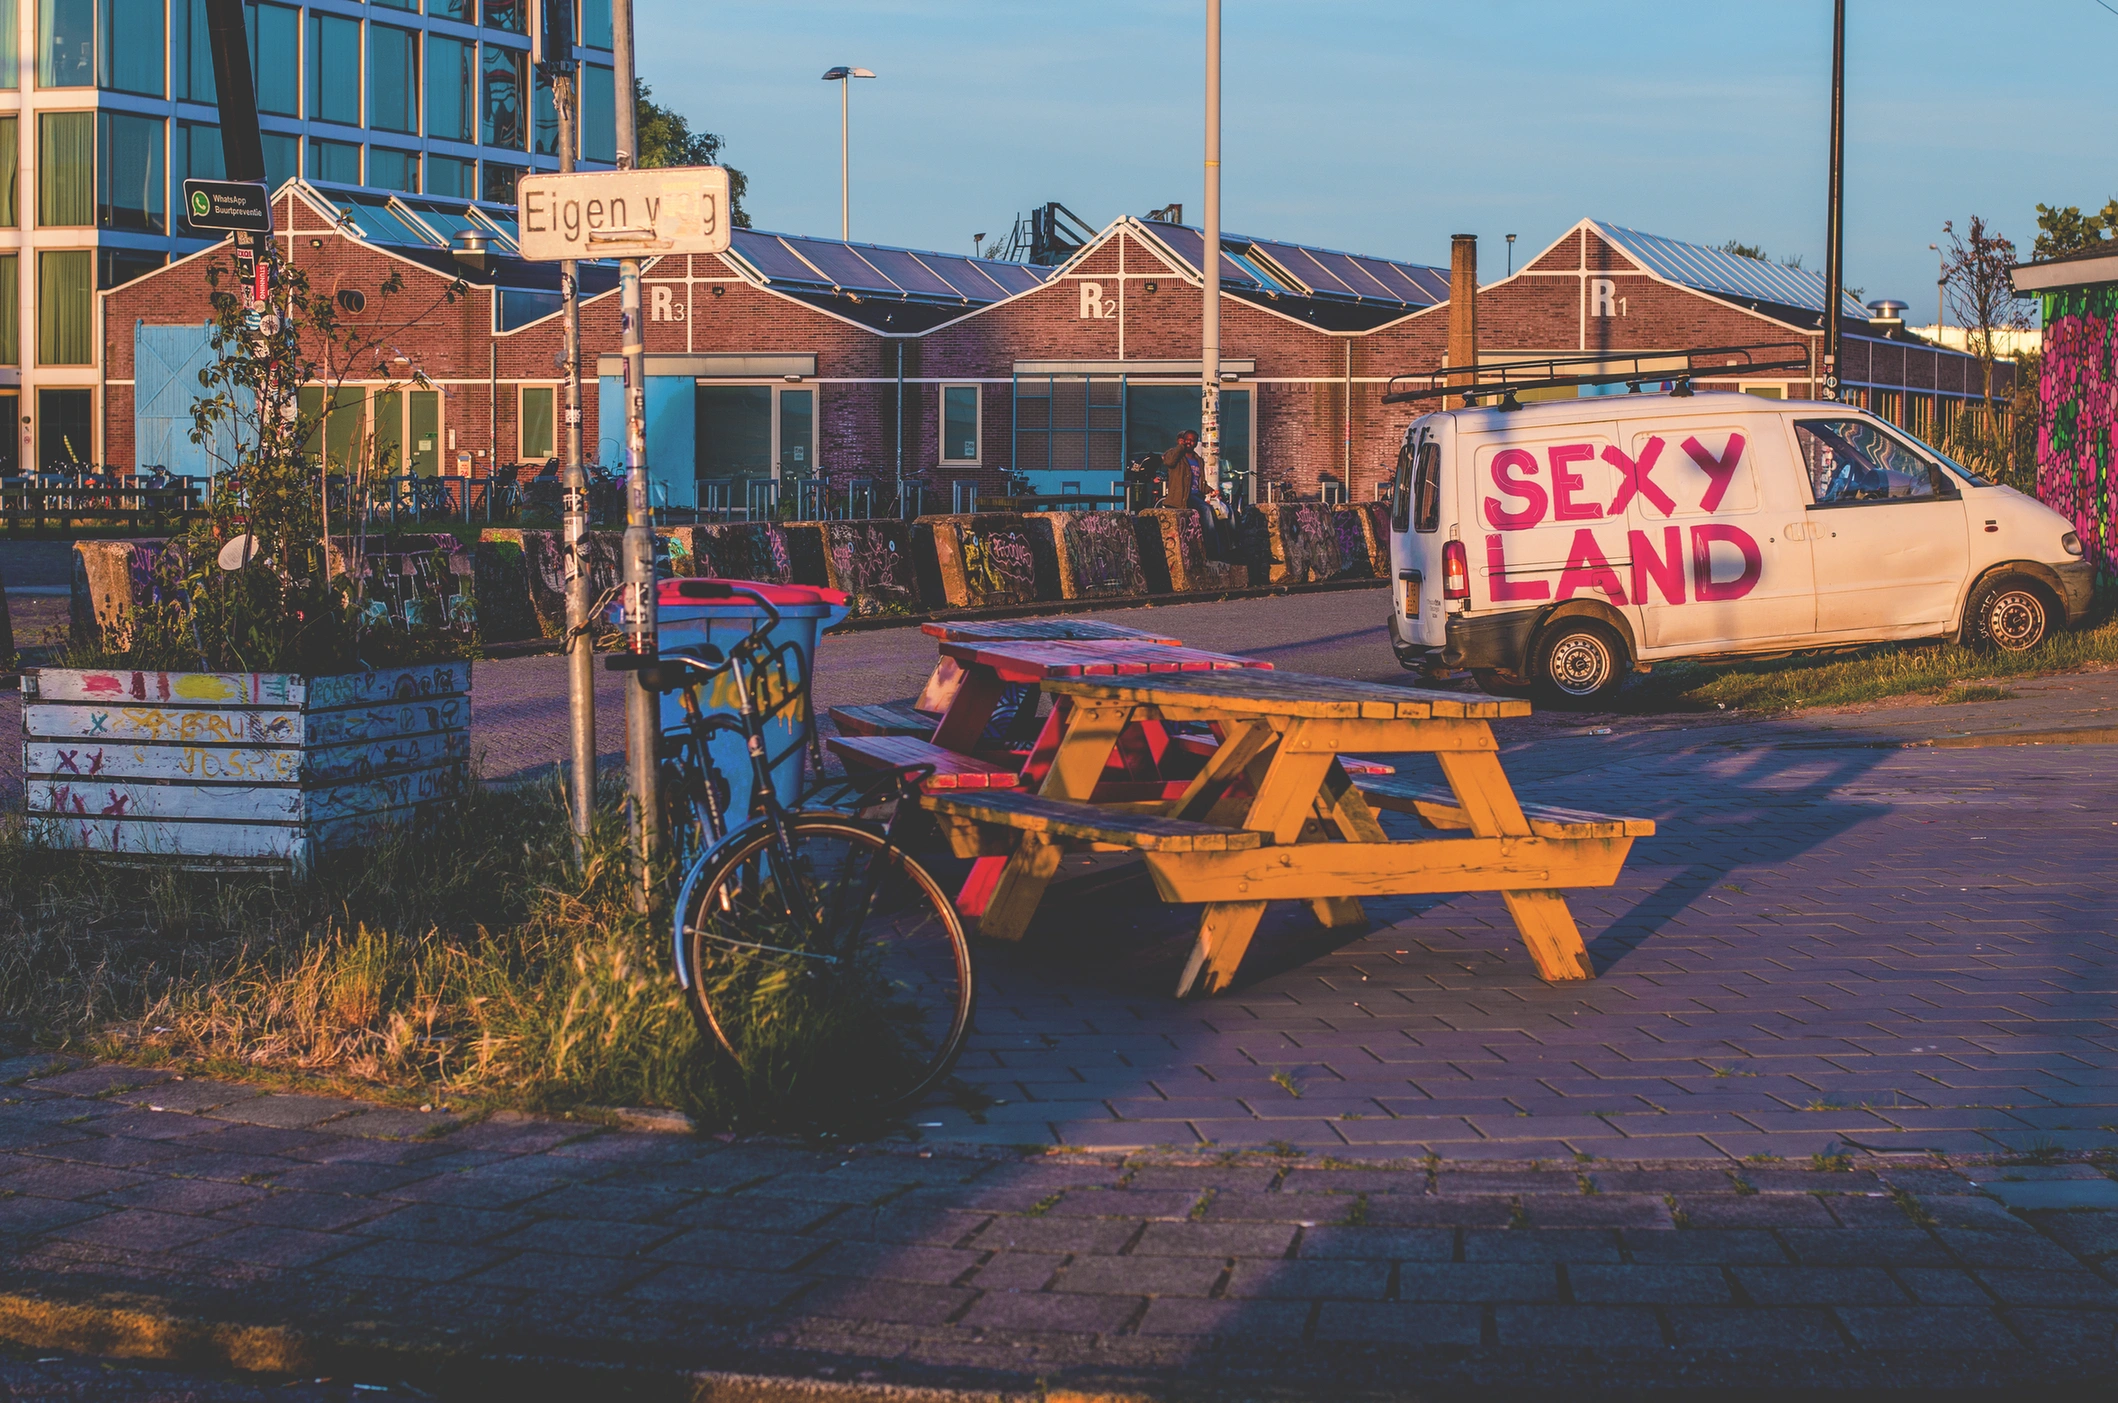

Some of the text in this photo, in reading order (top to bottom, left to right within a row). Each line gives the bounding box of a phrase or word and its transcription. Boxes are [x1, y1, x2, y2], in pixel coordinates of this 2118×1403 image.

[212, 194, 247, 206] WhatsApp
[214, 205, 263, 217] Buurtpreventie
[525, 190, 627, 242] Eigen
[651, 286, 685, 322] R3
[1080, 282, 1116, 319] R2
[1591, 279, 1627, 317] R1
[1484, 432, 1746, 531] SEXY
[1485, 523, 1763, 606] LAND
